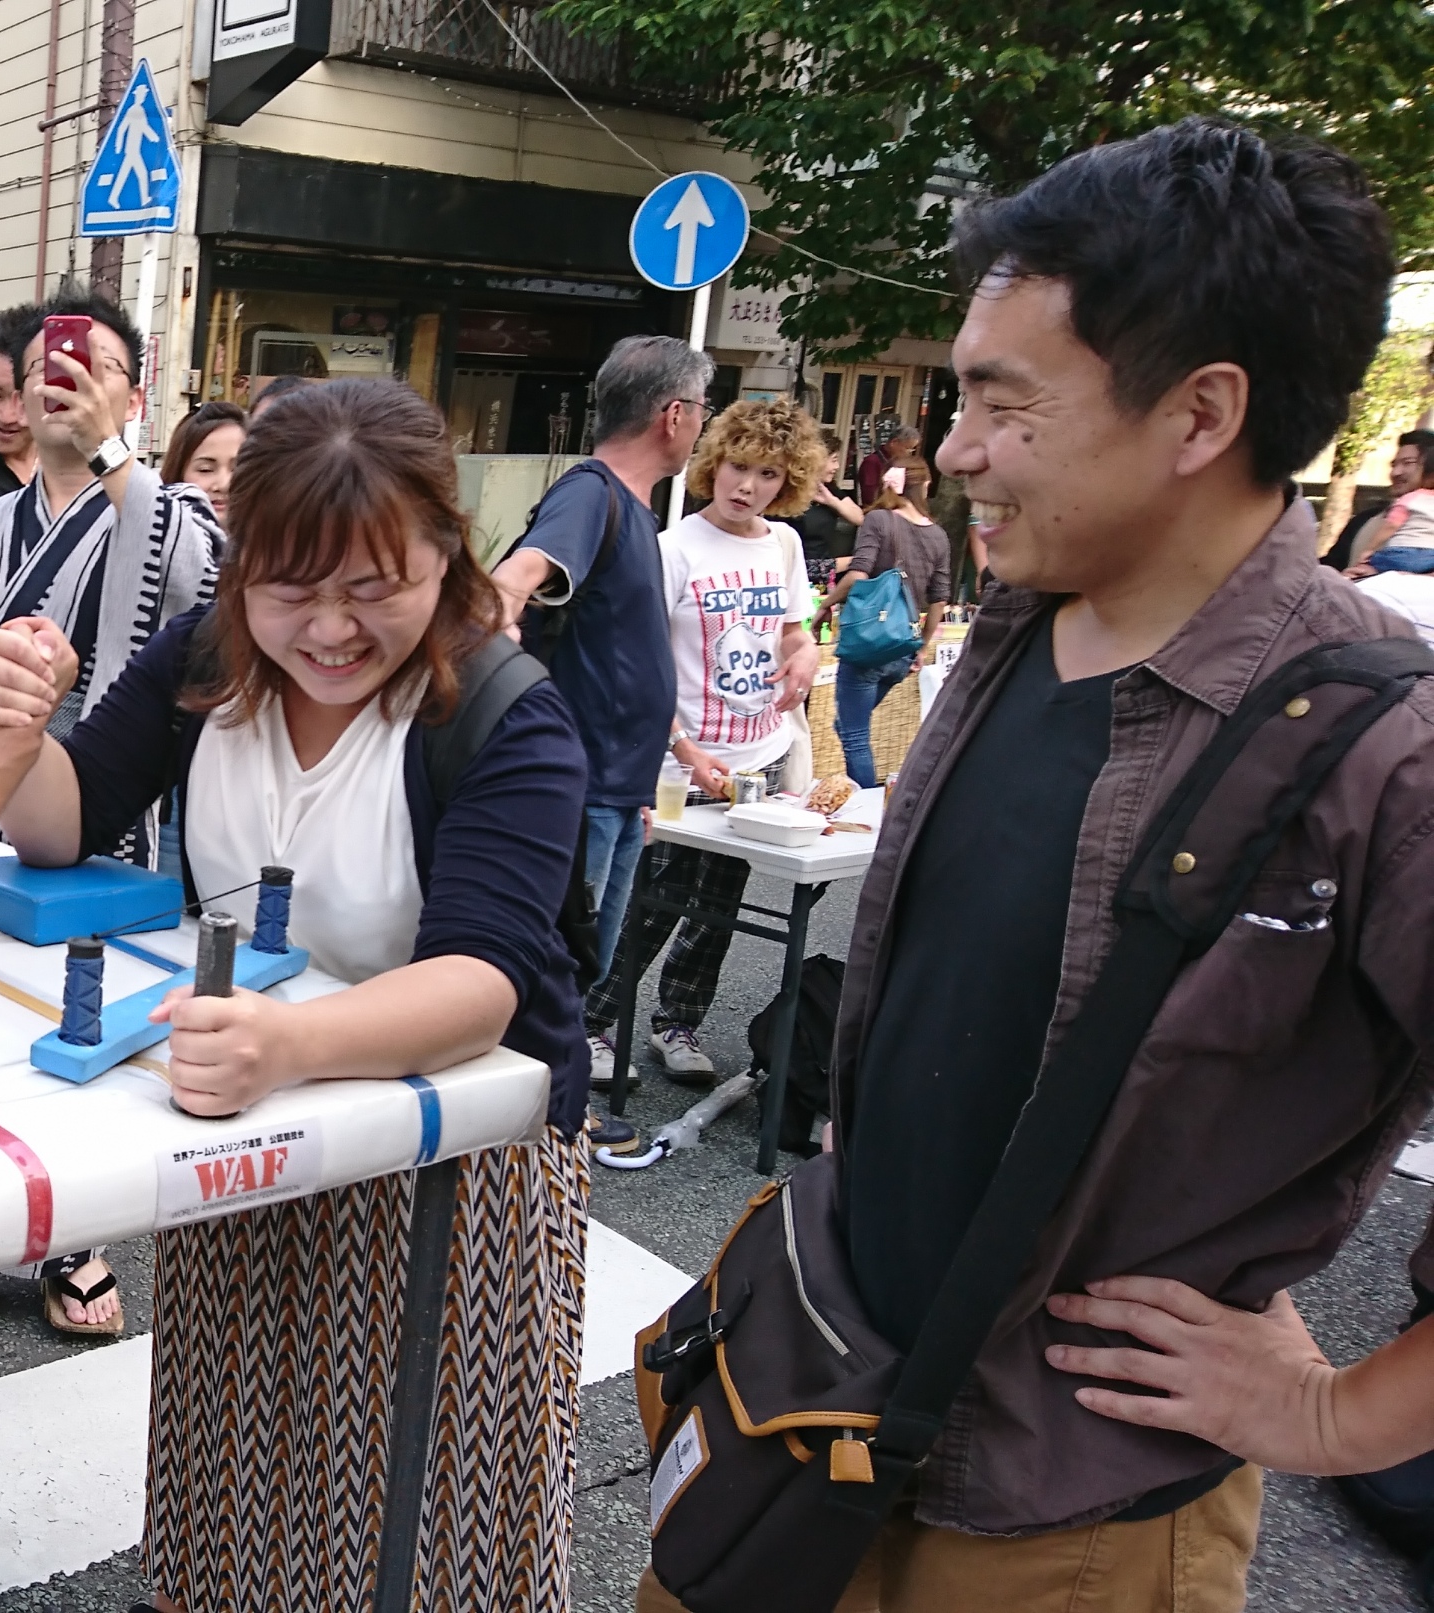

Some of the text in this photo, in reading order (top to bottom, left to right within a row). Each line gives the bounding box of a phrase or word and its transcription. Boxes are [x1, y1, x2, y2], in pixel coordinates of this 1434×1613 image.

[729, 650, 772, 670] POP
[194, 1147, 288, 1202] WAF
[171, 1206, 198, 1219] WORLD
